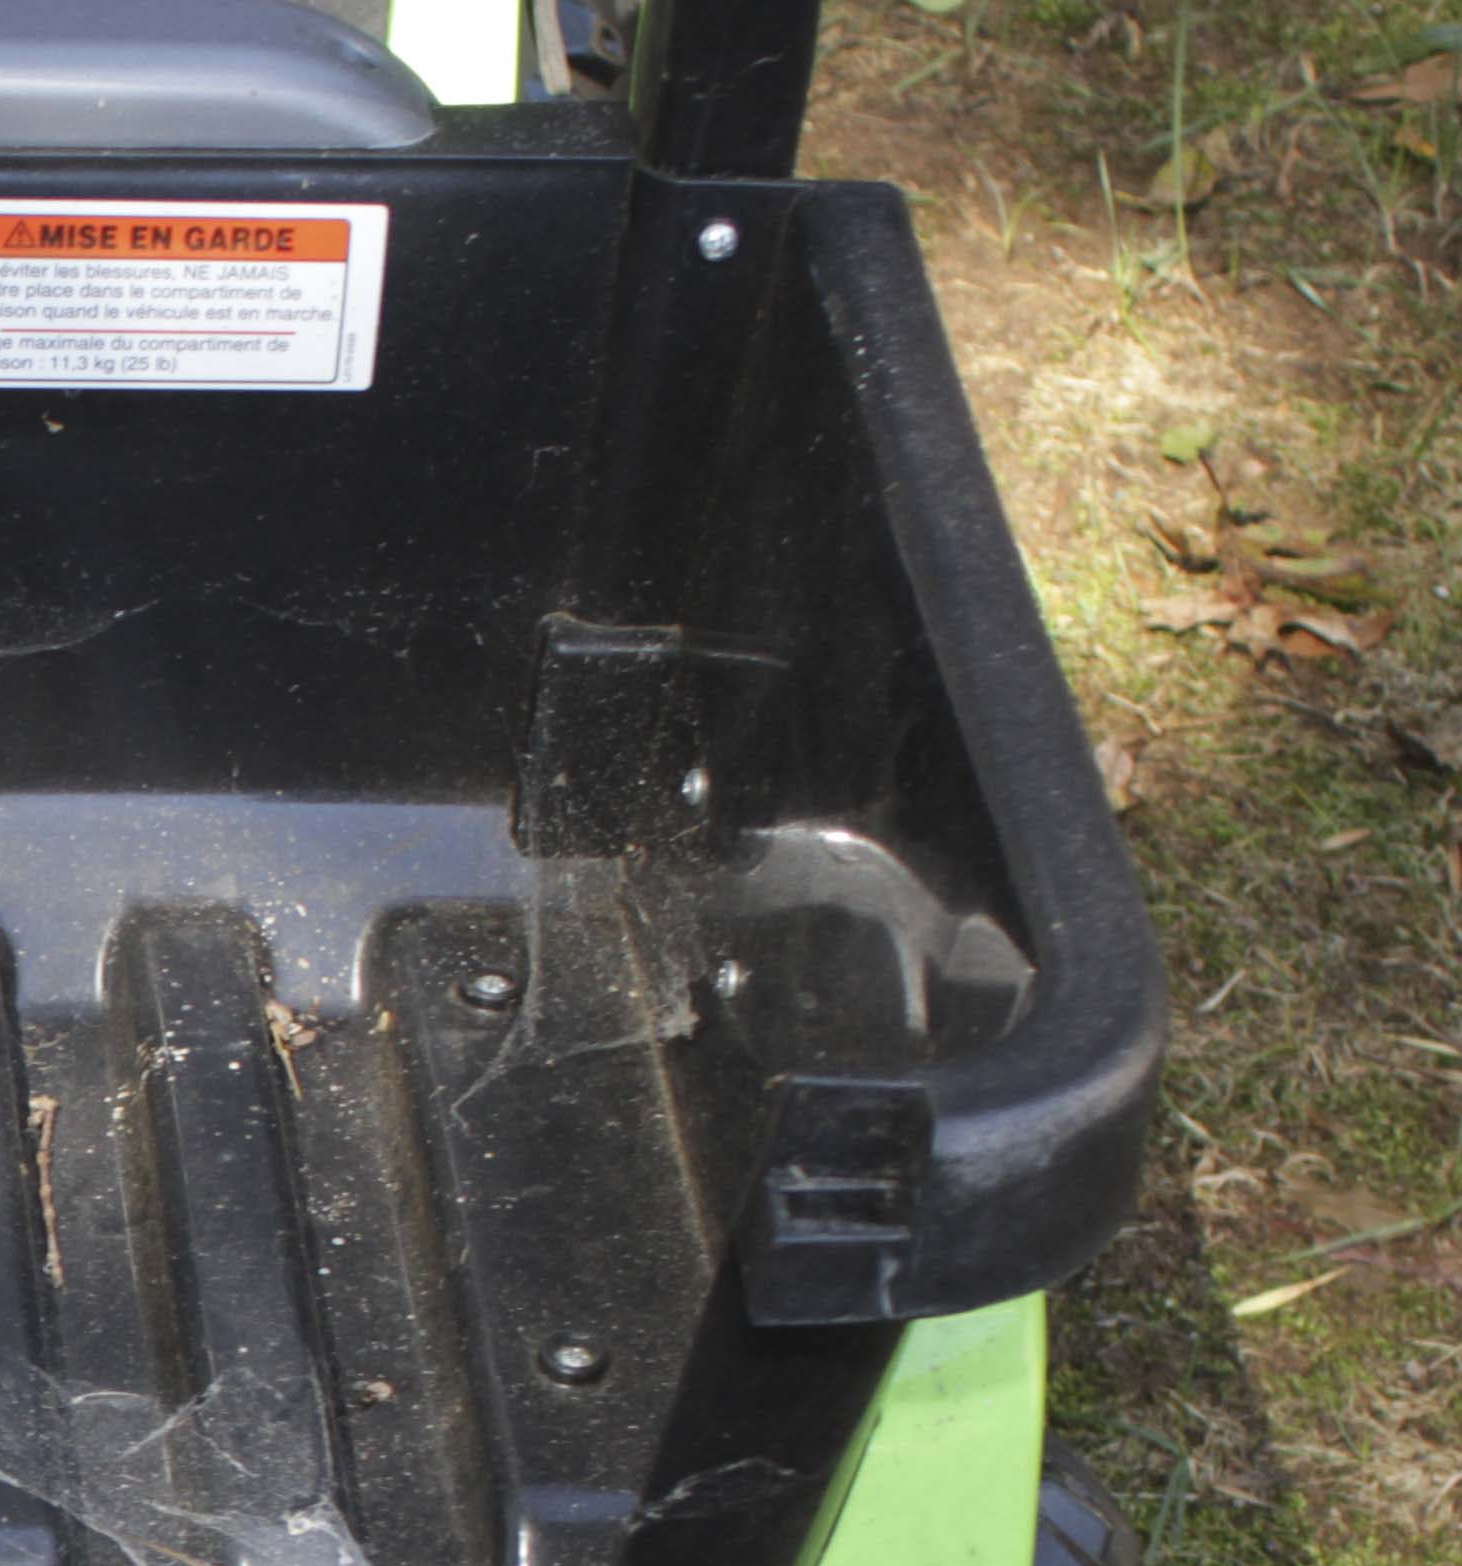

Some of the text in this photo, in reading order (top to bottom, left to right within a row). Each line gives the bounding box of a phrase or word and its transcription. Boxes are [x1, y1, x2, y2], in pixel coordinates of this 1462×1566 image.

[40, 224, 295, 252] MISE EN GARDE
[54, 264, 80, 279] les
[184, 265, 209, 280] NE
[218, 266, 289, 281] JAMAIS
[25, 283, 74, 300] place
[79, 284, 124, 298] dans
[130, 287, 145, 299] le
[151, 287, 274, 300] compartiment
[280, 288, 302, 300] de
[42, 304, 99, 320] quand
[104, 304, 120, 319] le
[126, 306, 200, 320] véhicule
[205, 306, 232, 320] est
[238, 309, 260, 320] en
[19, 336, 105, 350] maximale
[110, 336, 132, 350] du
[138, 338, 261, 353] compartiment
[267, 338, 289, 352] de
[94, 357, 115, 374] kg
[121, 356, 149, 372] (25
